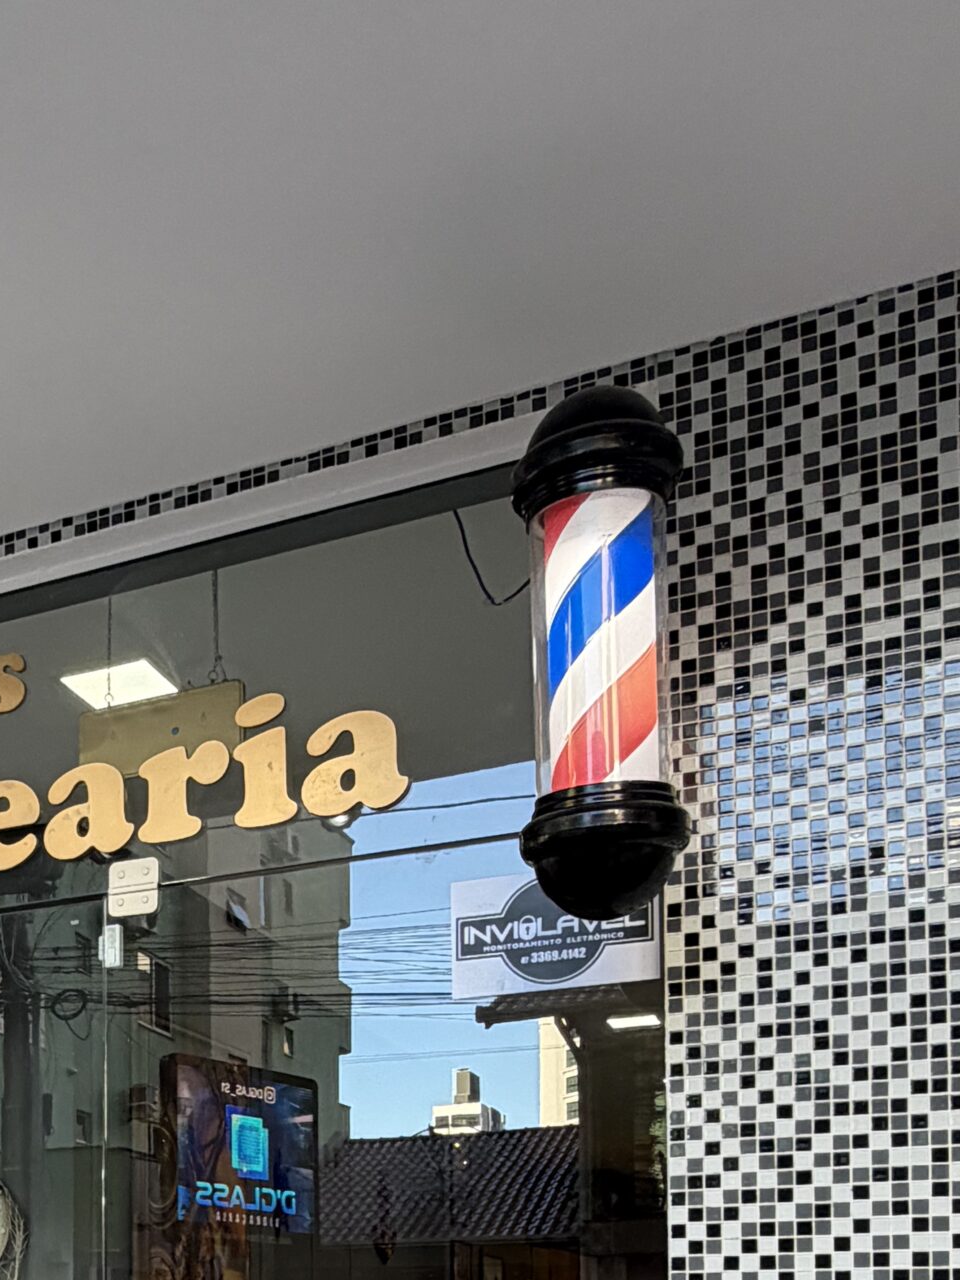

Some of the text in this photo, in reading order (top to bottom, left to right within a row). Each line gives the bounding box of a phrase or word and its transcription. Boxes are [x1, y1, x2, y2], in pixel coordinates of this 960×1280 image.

[483, 931, 624, 952] MONITORAMENTO ELETRÔNICO
[530, 946, 587, 963] 3369.4142
